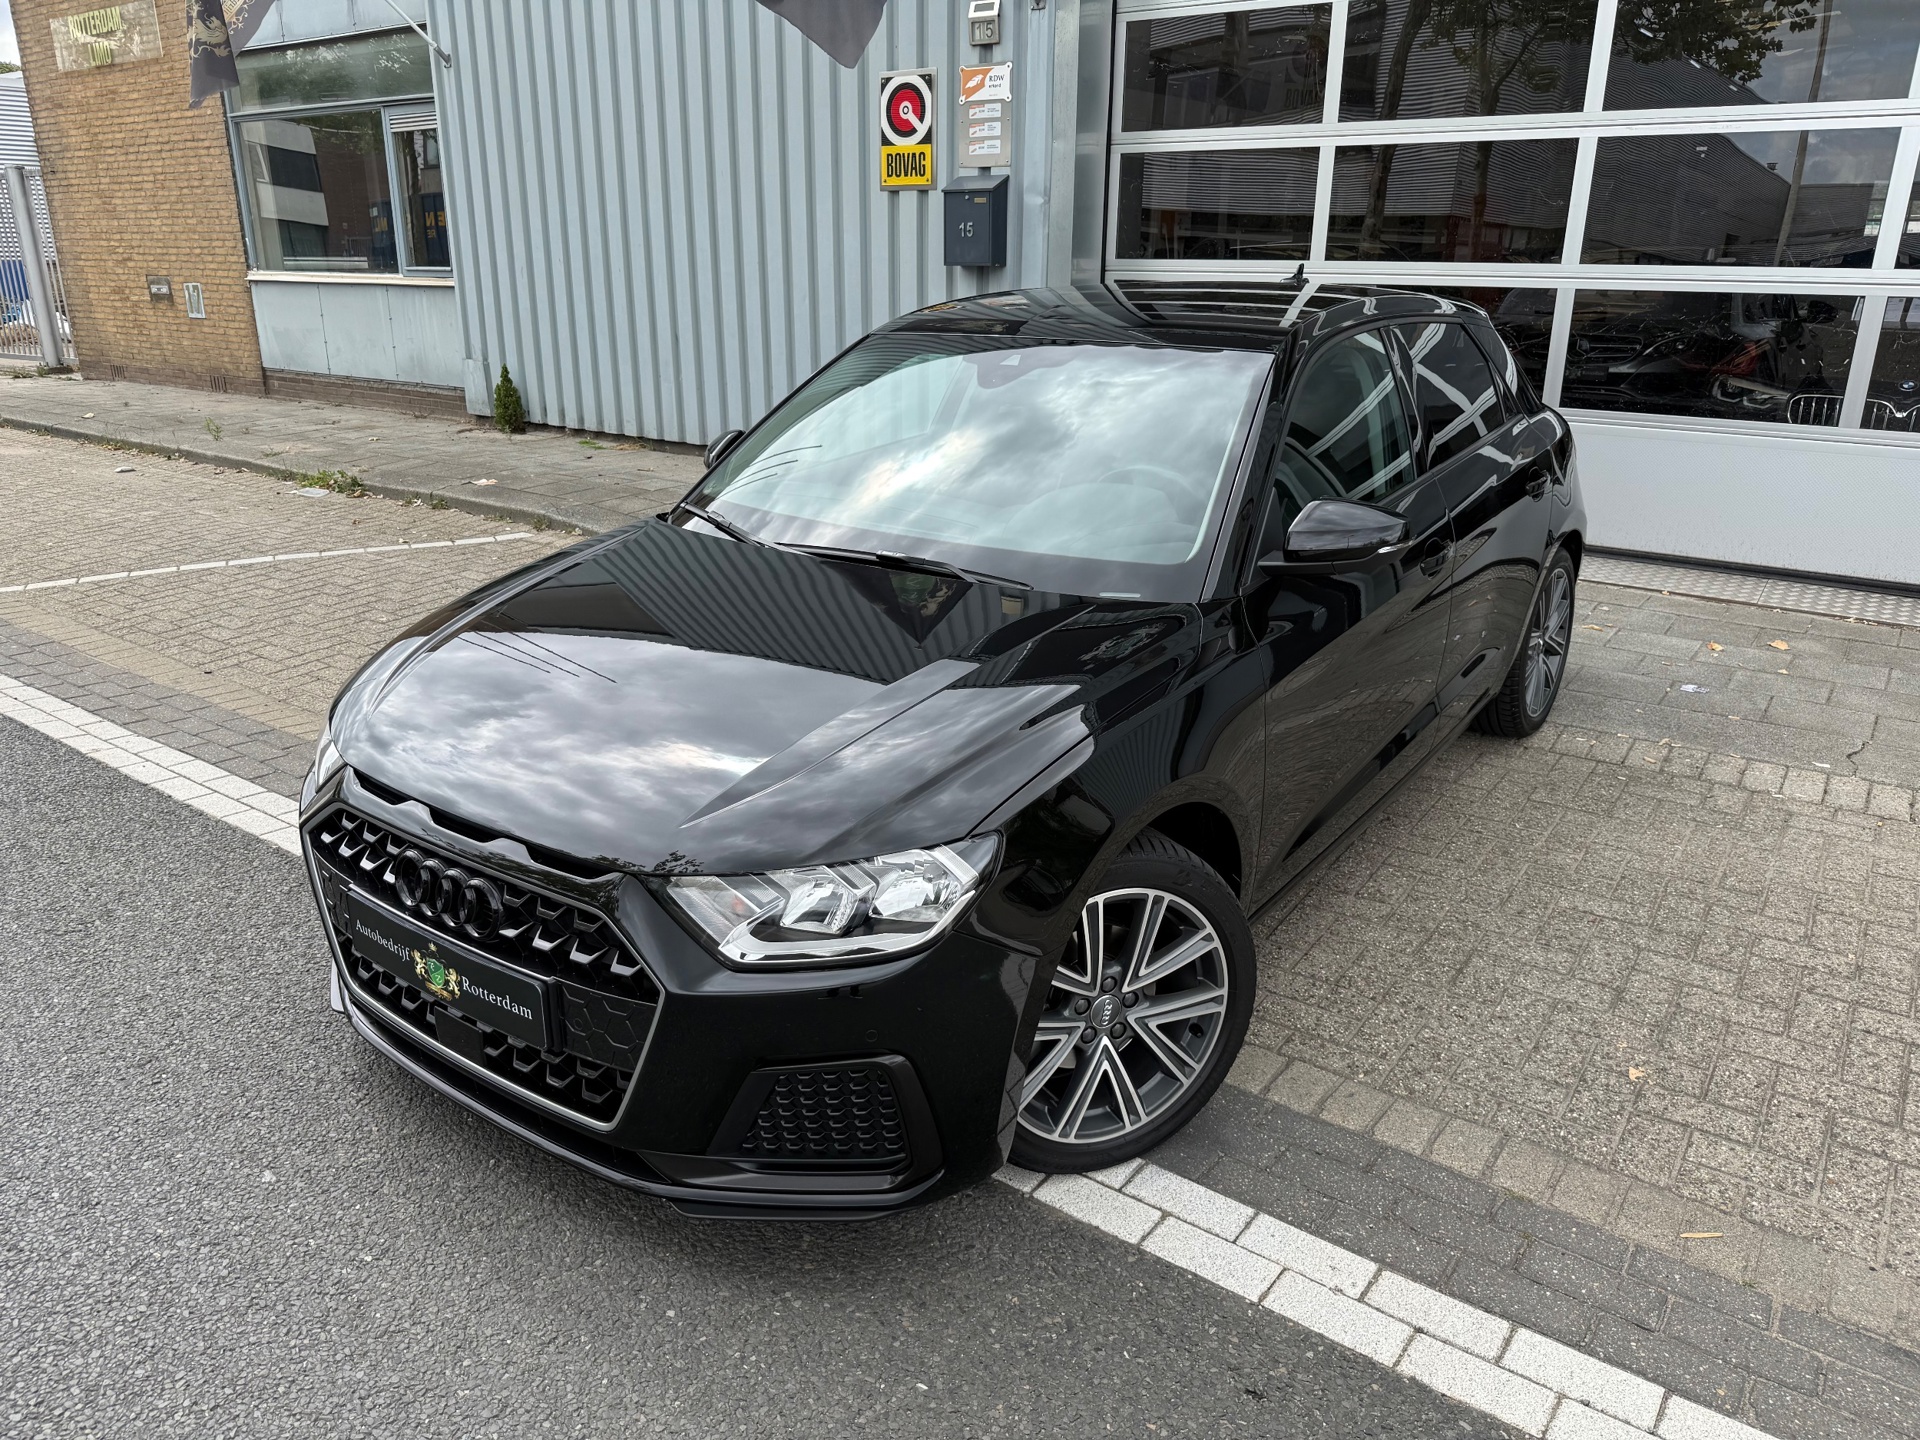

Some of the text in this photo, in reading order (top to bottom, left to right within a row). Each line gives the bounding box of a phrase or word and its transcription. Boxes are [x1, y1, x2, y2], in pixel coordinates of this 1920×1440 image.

[68, 6, 122, 40] ROTTERDAM
[975, 23, 994, 40] 15
[988, 74, 1005, 82] RDW
[886, 152, 926, 178] BOVAG
[959, 222, 974, 237] 15
[355, 919, 533, 1020] Autobedrijf Rotterdam
